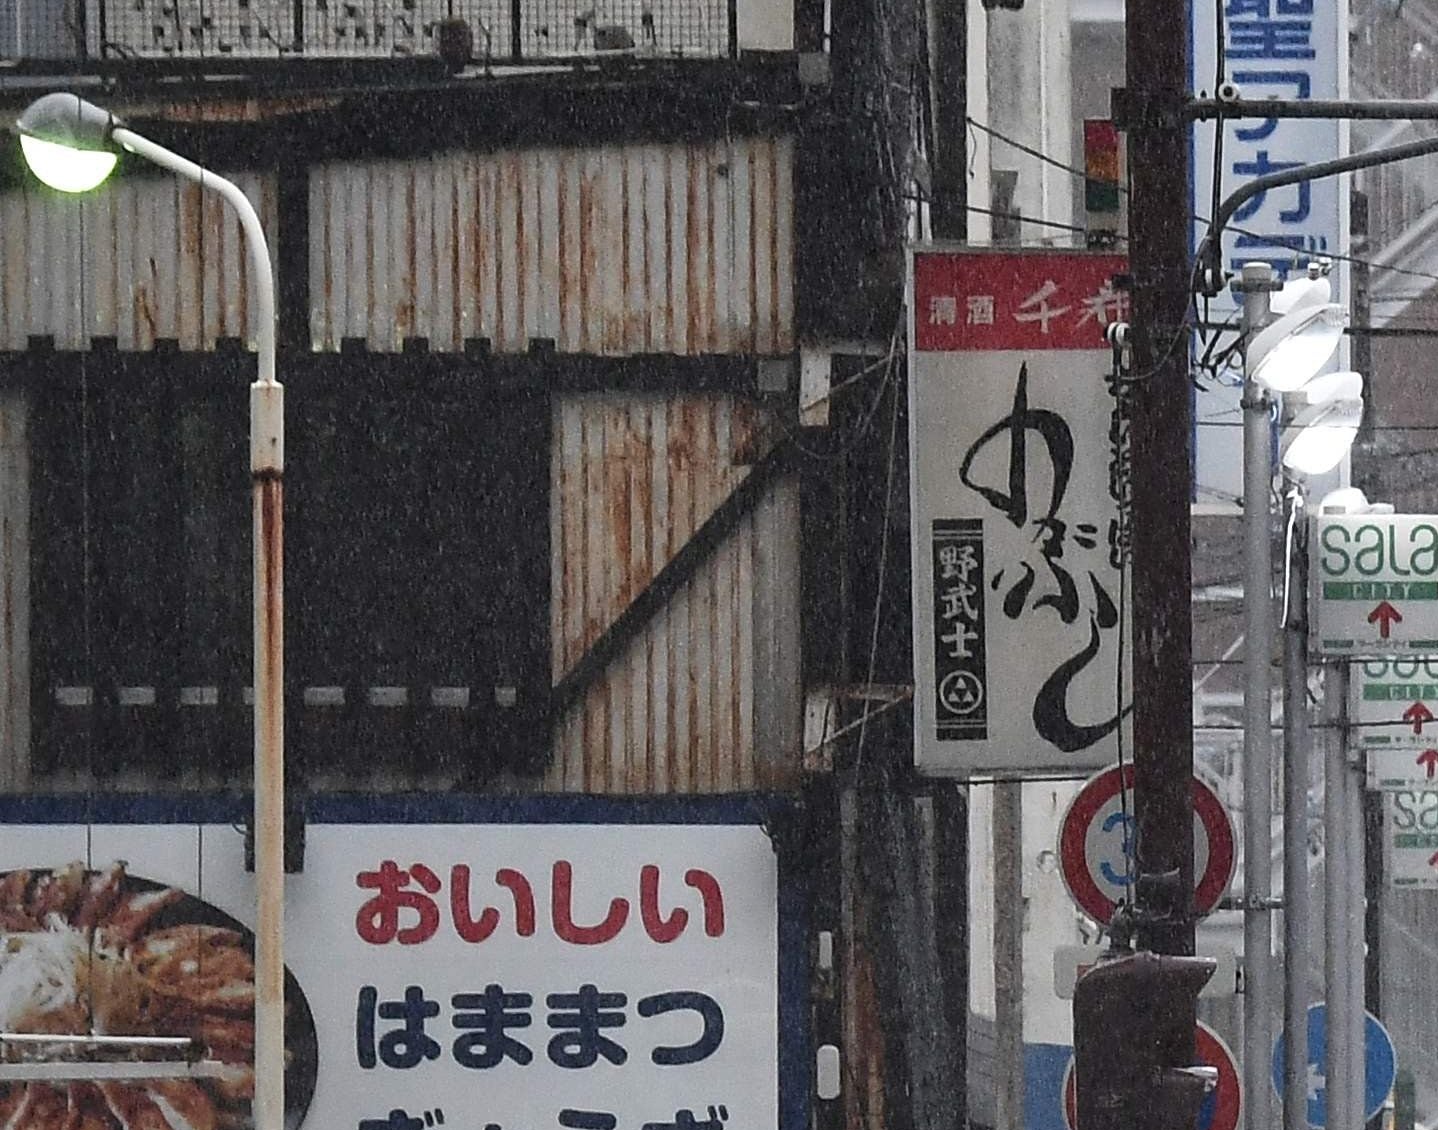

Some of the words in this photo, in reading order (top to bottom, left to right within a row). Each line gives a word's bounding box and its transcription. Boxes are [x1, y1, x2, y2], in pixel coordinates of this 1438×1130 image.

[940, 544, 980, 660] 野武士
[1352, 583, 1412, 598] CITY
[354, 859, 726, 946] おいしい
[355, 984, 727, 1070] はままつ
